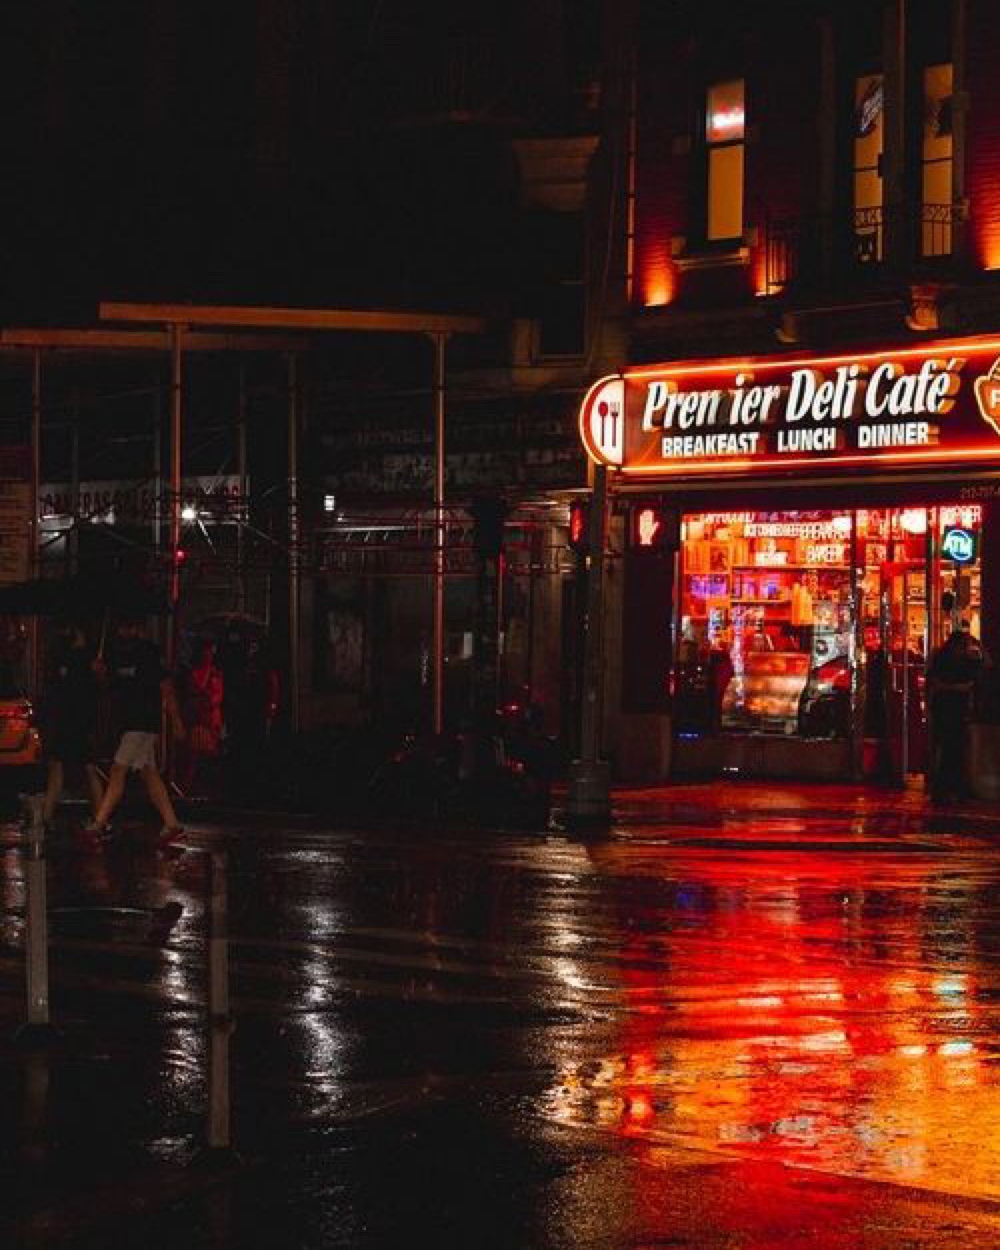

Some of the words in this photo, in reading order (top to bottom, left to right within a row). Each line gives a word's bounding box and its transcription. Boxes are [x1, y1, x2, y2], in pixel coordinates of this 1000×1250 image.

[785, 367, 860, 423] Deli
[865, 358, 957, 418] Café
[661, 429, 759, 458] BREAKFAST
[777, 426, 837, 451] LUNCH
[858, 421, 930, 447] DINNER
